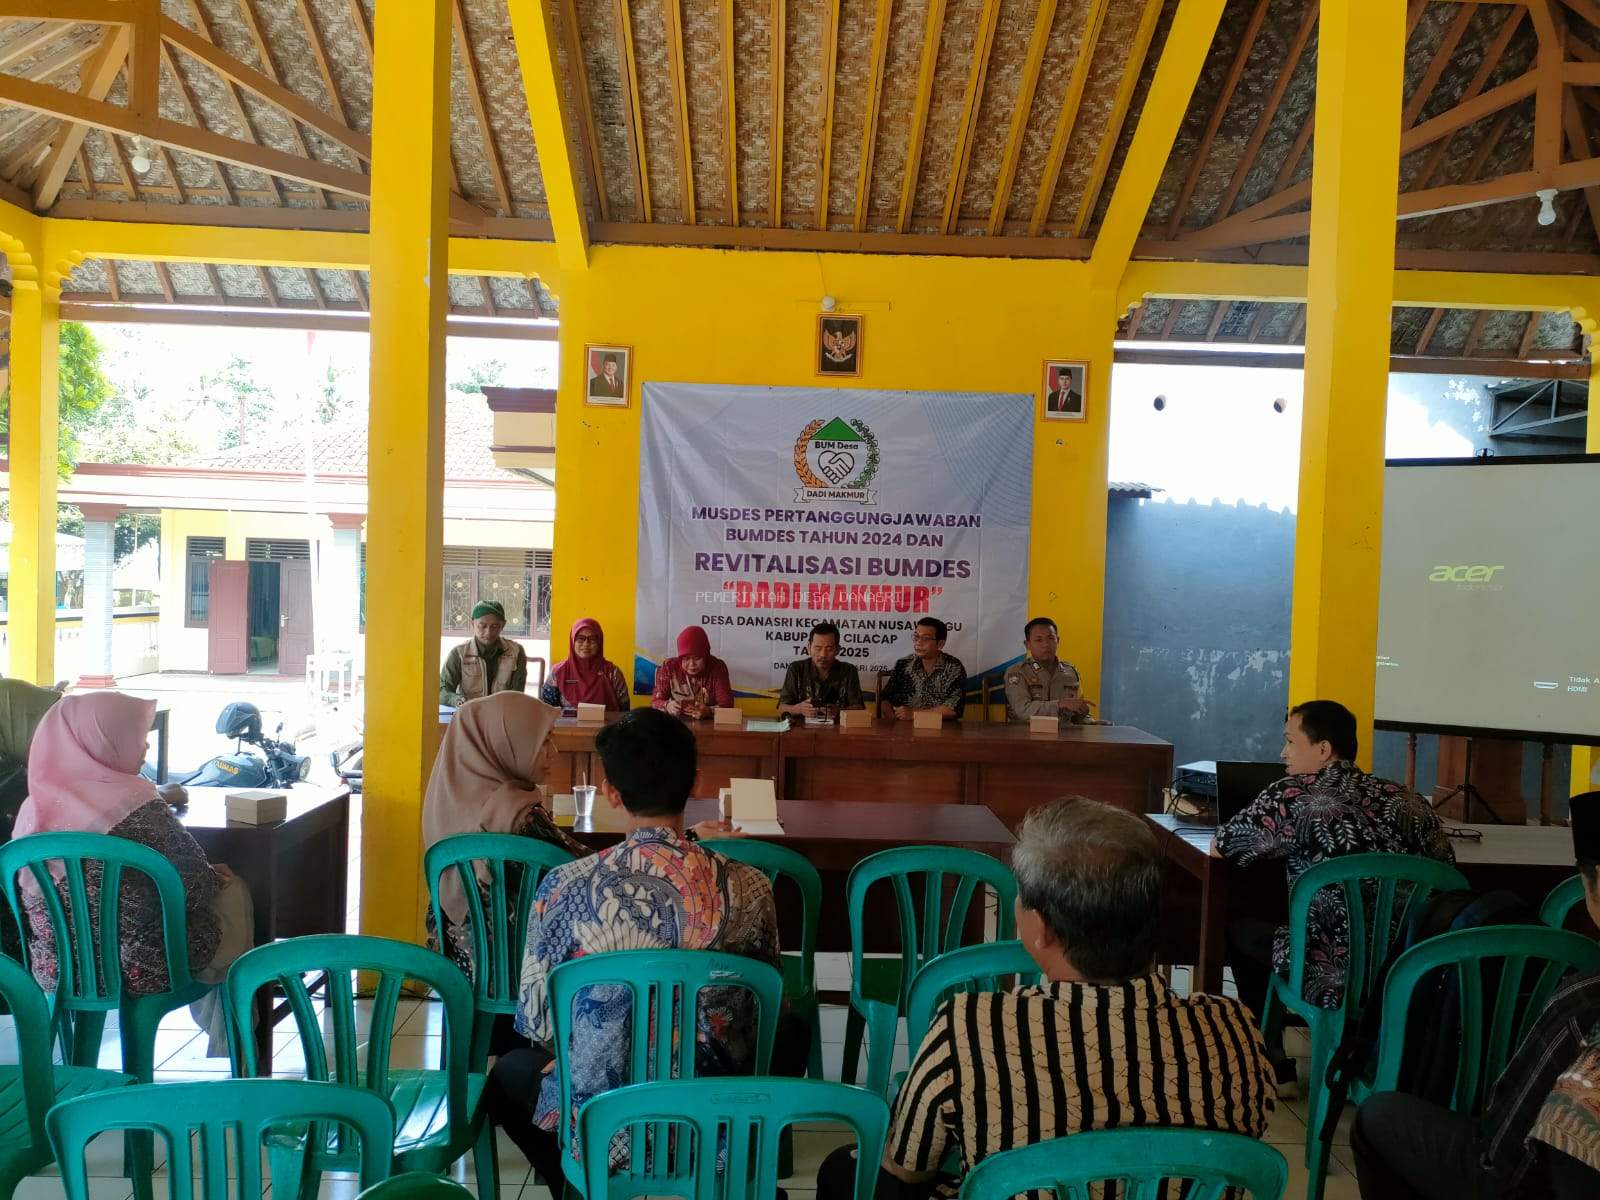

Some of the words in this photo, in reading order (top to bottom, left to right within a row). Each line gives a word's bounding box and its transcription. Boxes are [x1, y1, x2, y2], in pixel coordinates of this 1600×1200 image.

[815, 441, 835, 449] BUM
[837, 441, 859, 450] Desa
[806, 490, 827, 498] DADI
[828, 491, 865, 499] MAKMUR
[692, 506, 761, 521] MUSDES
[764, 508, 981, 528] PERTANGGUNGJAWABAN
[726, 528, 796, 543] BUMDES
[799, 530, 858, 545] TAHUN
[862, 532, 903, 546] 2024
[906, 534, 944, 547] DAN
[695, 552, 862, 576] REVITALISASI
[867, 557, 971, 579] BUMDES
[1429, 565, 1505, 582] acer
[701, 615, 734, 626] DESA
[737, 616, 793, 628] DANASRI
[879, 620, 963, 632] NUSAGU
[843, 633, 898, 644] CILACAP
[839, 647, 870, 658] 2025
[1569, 676, 1591, 684] Tidak
